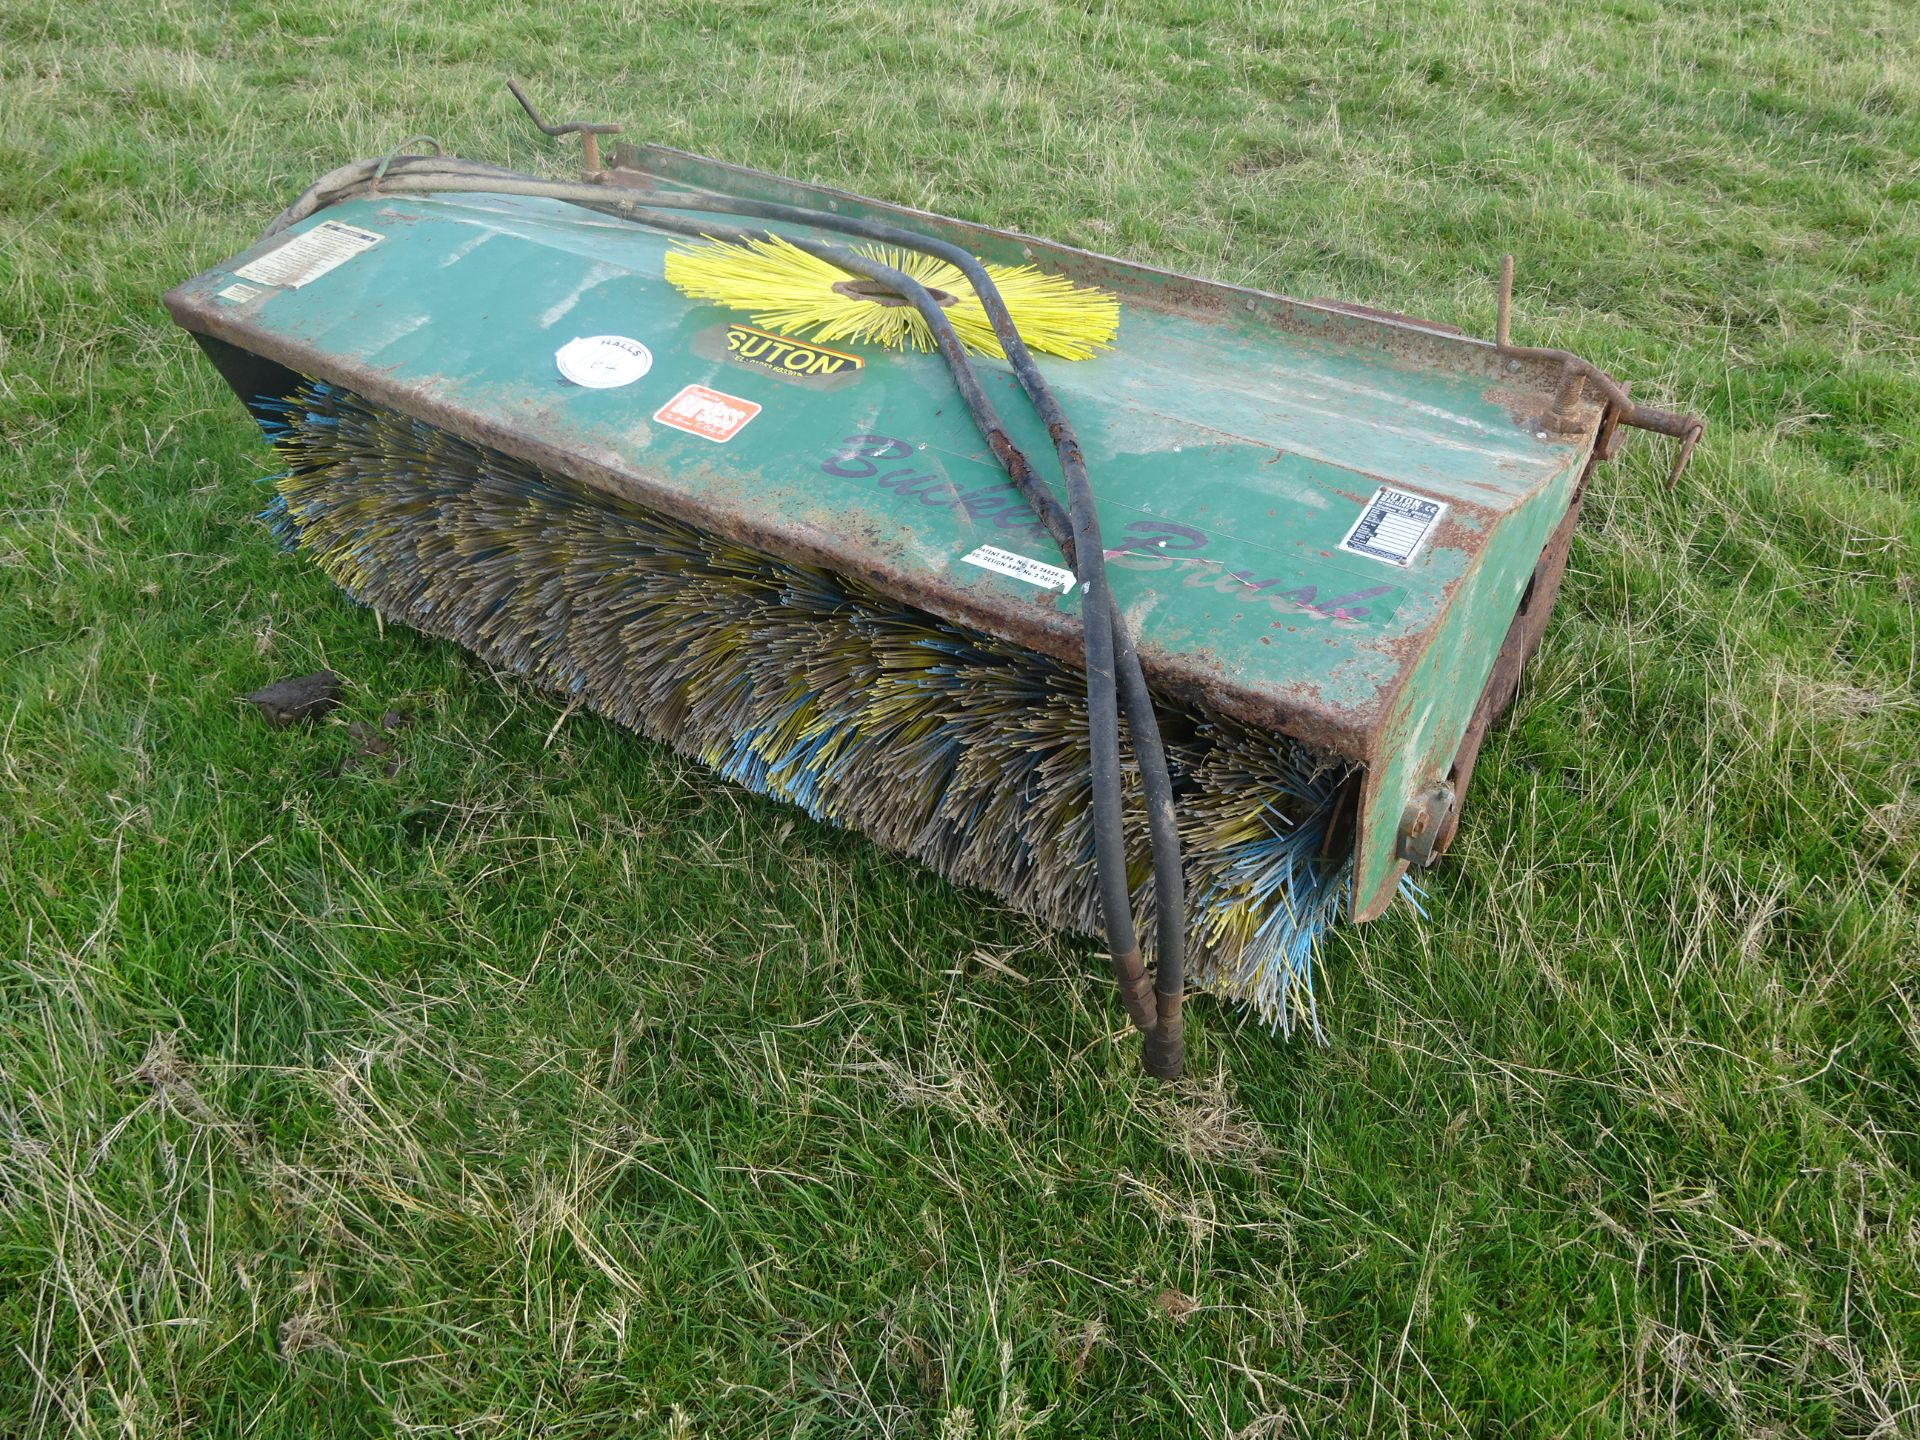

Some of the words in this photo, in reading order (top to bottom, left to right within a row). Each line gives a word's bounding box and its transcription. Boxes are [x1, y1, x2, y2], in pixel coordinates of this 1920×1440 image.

[600, 340, 642, 357] HALLS
[726, 330, 844, 375] SUTON
[820, 435, 1056, 538] Bucke
[1383, 490, 1422, 507] SUTON
[978, 547, 1001, 557] PATENT
[983, 556, 1007, 567] DESIGN
